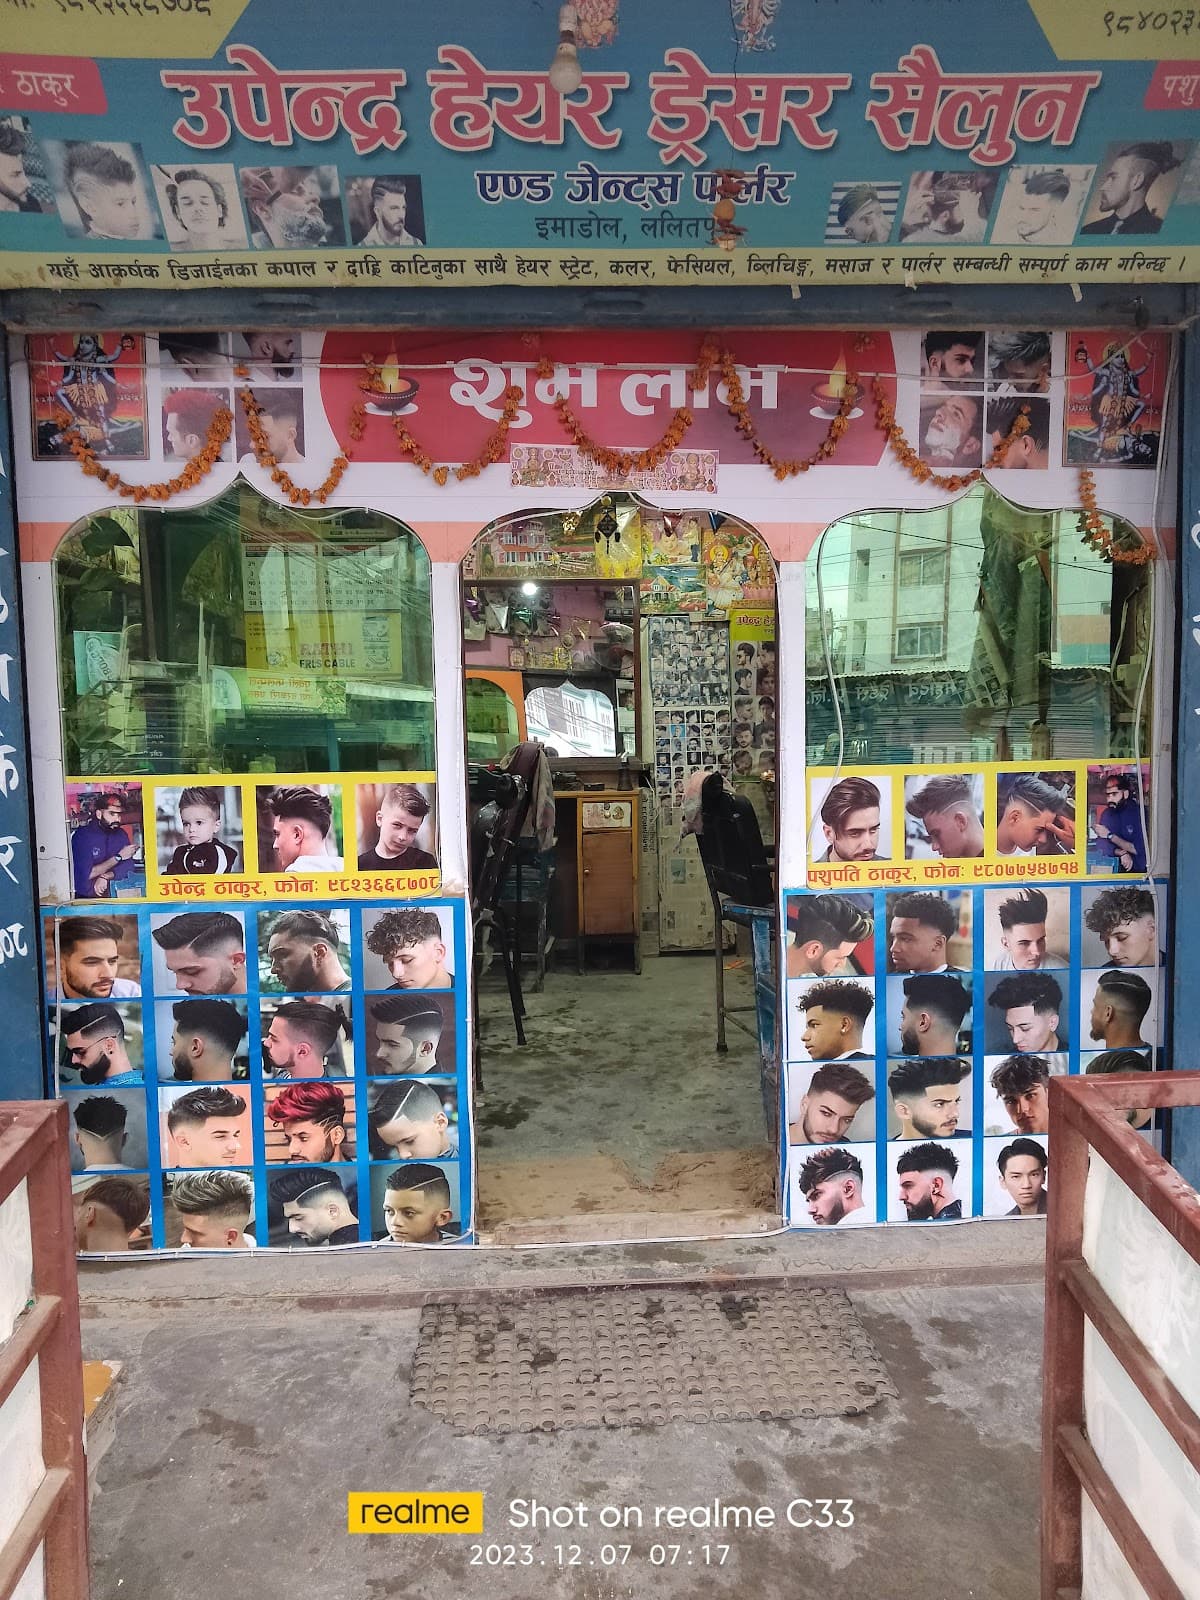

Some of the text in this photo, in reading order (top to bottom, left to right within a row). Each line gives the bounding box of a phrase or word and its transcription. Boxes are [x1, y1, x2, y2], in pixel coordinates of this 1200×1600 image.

[1103, 11, 1200, 37] ९८४०२३
[11, 70, 79, 107] ठाकुर
[161, 44, 1103, 167] उपेन्द्र हेयर ड्रेसर सैलुन
[475, 171, 556, 204] एण्ड
[565, 161, 684, 210] जेन्ट्स
[534, 210, 627, 244] इमाडोल,
[46, 256, 80, 281] यहाँ
[88, 259, 160, 279] आकर्षक
[167, 258, 258, 280] डिजाईनका
[265, 260, 317, 278] कपाल
[324, 260, 339, 278] र
[389, 254, 466, 280] काटिनुका
[474, 253, 507, 274] साथै
[515, 255, 552, 277] हेयर
[559, 255, 598, 280] स्ट्रेट,
[608, 259, 655, 279] कलर,
[667, 253, 735, 278] फेसियल,
[825, 257, 875, 275] मसाज
[881, 257, 895, 275] र
[901, 252, 946, 275] पार्लर
[953, 252, 1012, 272] सम्बन्धी
[1018, 253, 1069, 279] सम्पूर्ण
[1075, 256, 1112, 271] काम
[1117, 251, 1171, 272] गरिन्छ
[447, 358, 787, 428] शुभ लाभ
[324, 658, 356, 668] CABLE
[159, 878, 206, 897] उपेन्द्र
[214, 879, 267, 898] ठाकुर,
[328, 875, 439, 892] ९८२३६६८७०८
[808, 864, 861, 886] पशुपति
[868, 866, 917, 883] ठाकुर,
[973, 861, 1079, 877] ९८०७७५४७१४
